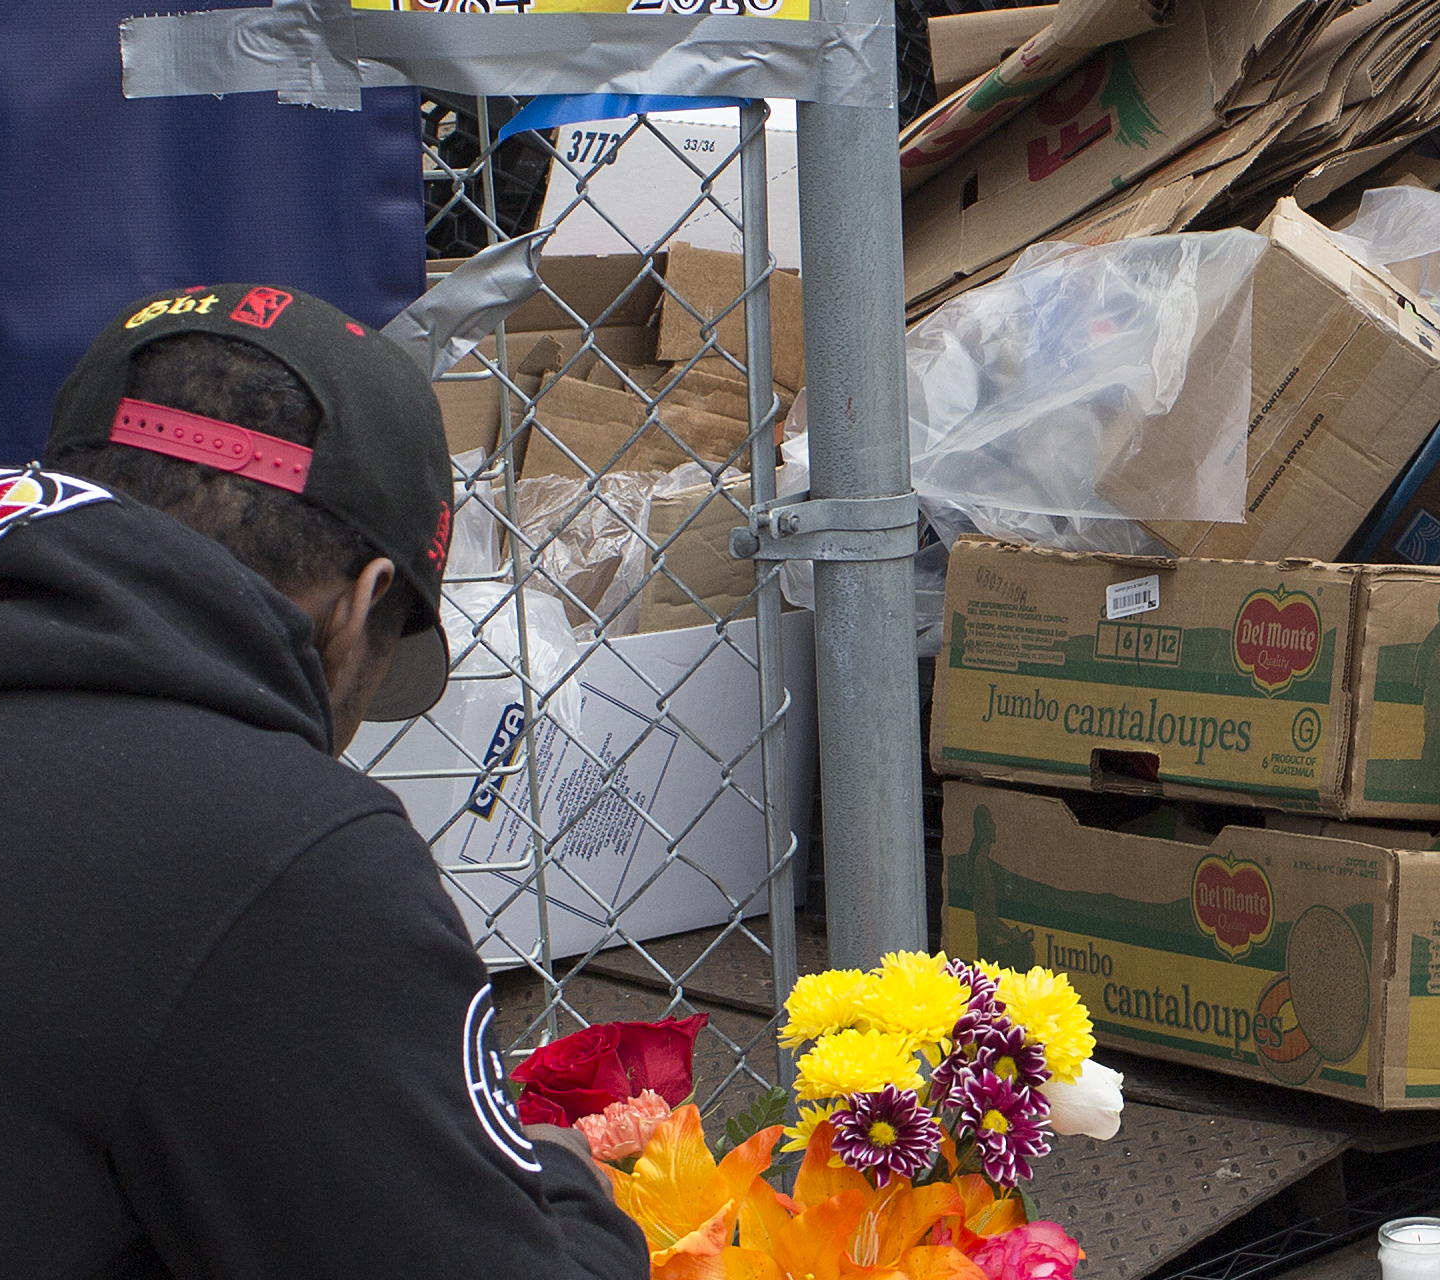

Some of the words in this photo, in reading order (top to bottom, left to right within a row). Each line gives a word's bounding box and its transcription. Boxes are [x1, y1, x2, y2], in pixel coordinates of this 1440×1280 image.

[1122, 631, 1133, 650] 6
[1142, 632, 1153, 652] 9
[1161, 633, 1177, 654] 12
[1240, 619, 1264, 654] Del
[1266, 622, 1316, 652] Monte
[1258, 649, 1290, 671] Quality
[982, 683, 1058, 722] Jumbo
[1063, 698, 1252, 765] cantaloupes
[1270, 752, 1301, 766] PRODUCT
[1303, 756, 1316, 767] OF
[1272, 764, 1315, 778] GUATEMALA
[1198, 882, 1221, 908] Del
[1222, 886, 1268, 916] Monte
[1044, 932, 1113, 977] Jumbo
[1103, 983, 1284, 1060] cantaloupes
